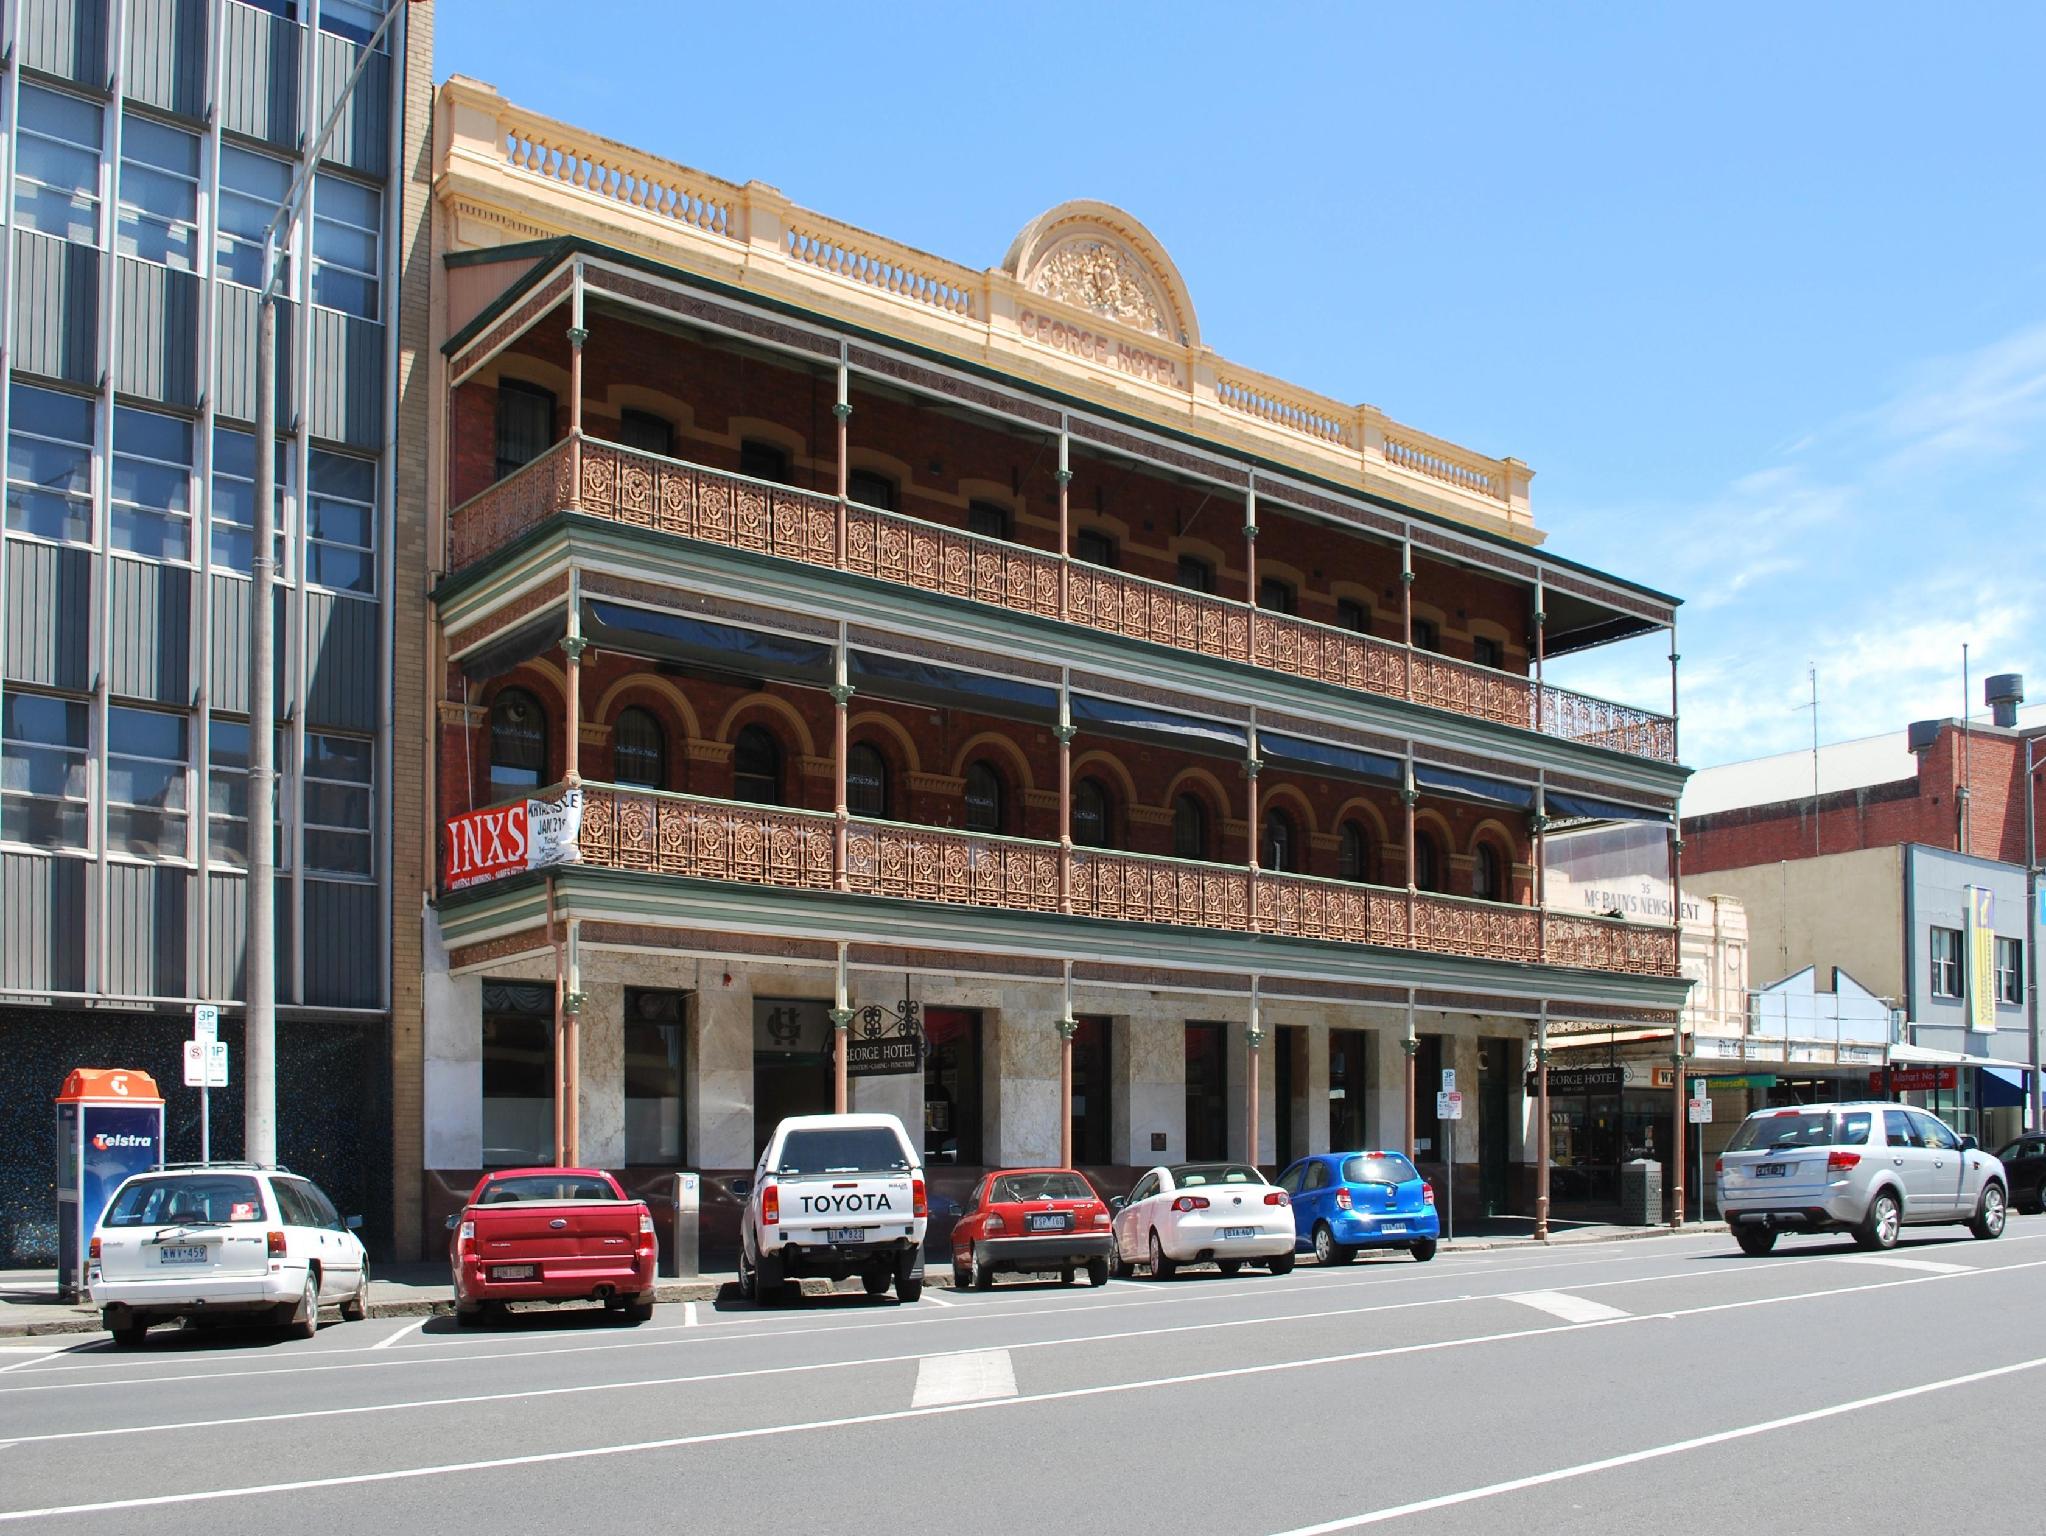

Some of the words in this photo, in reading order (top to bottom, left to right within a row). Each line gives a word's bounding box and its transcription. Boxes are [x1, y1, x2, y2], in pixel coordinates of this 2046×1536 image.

[1020, 310, 1109, 365] GEORGE
[448, 807, 524, 875] INXS
[1640, 897, 1700, 921] NEWSAENT
[198, 1010, 215, 1021] 3P
[211, 1046, 225, 1057] 1P
[847, 1046, 880, 1062] EORGE
[883, 1044, 916, 1058] HOTEL
[1547, 1074, 1583, 1085] EORGE
[1584, 1072, 1618, 1084] HOTEL
[95, 1133, 152, 1147] Telstra
[799, 1193, 892, 1213] TOYOTA
